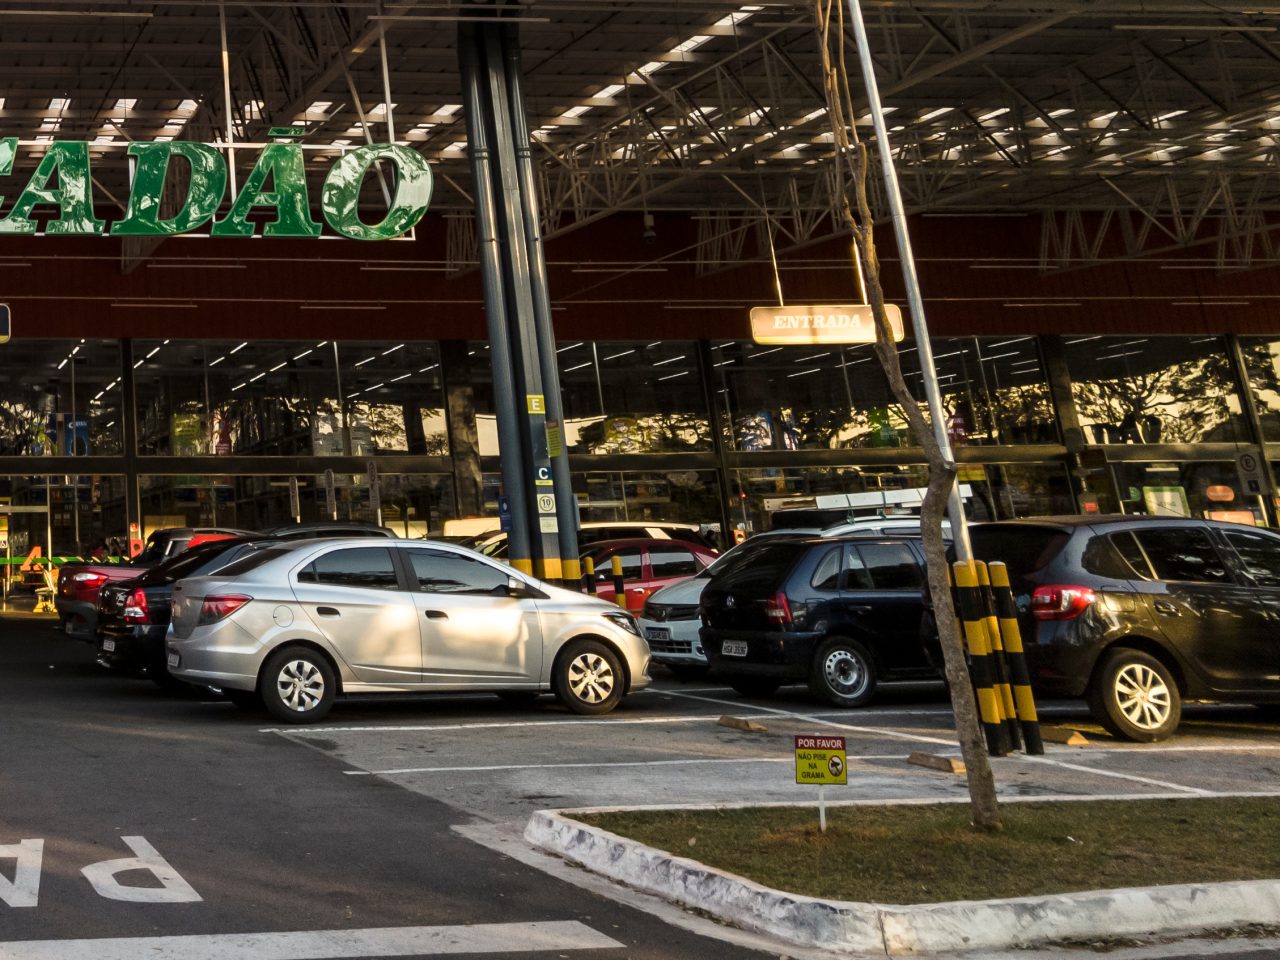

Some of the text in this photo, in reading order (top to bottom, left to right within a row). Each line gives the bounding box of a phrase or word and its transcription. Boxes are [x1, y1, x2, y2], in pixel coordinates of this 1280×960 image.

[772, 313, 863, 330] ENTRADA
[531, 398, 541, 410] E
[538, 467, 549, 480] C
[798, 738, 842, 749] POR FAVOR
[808, 762, 818, 770] NA
[801, 771, 826, 779] GRAMA
